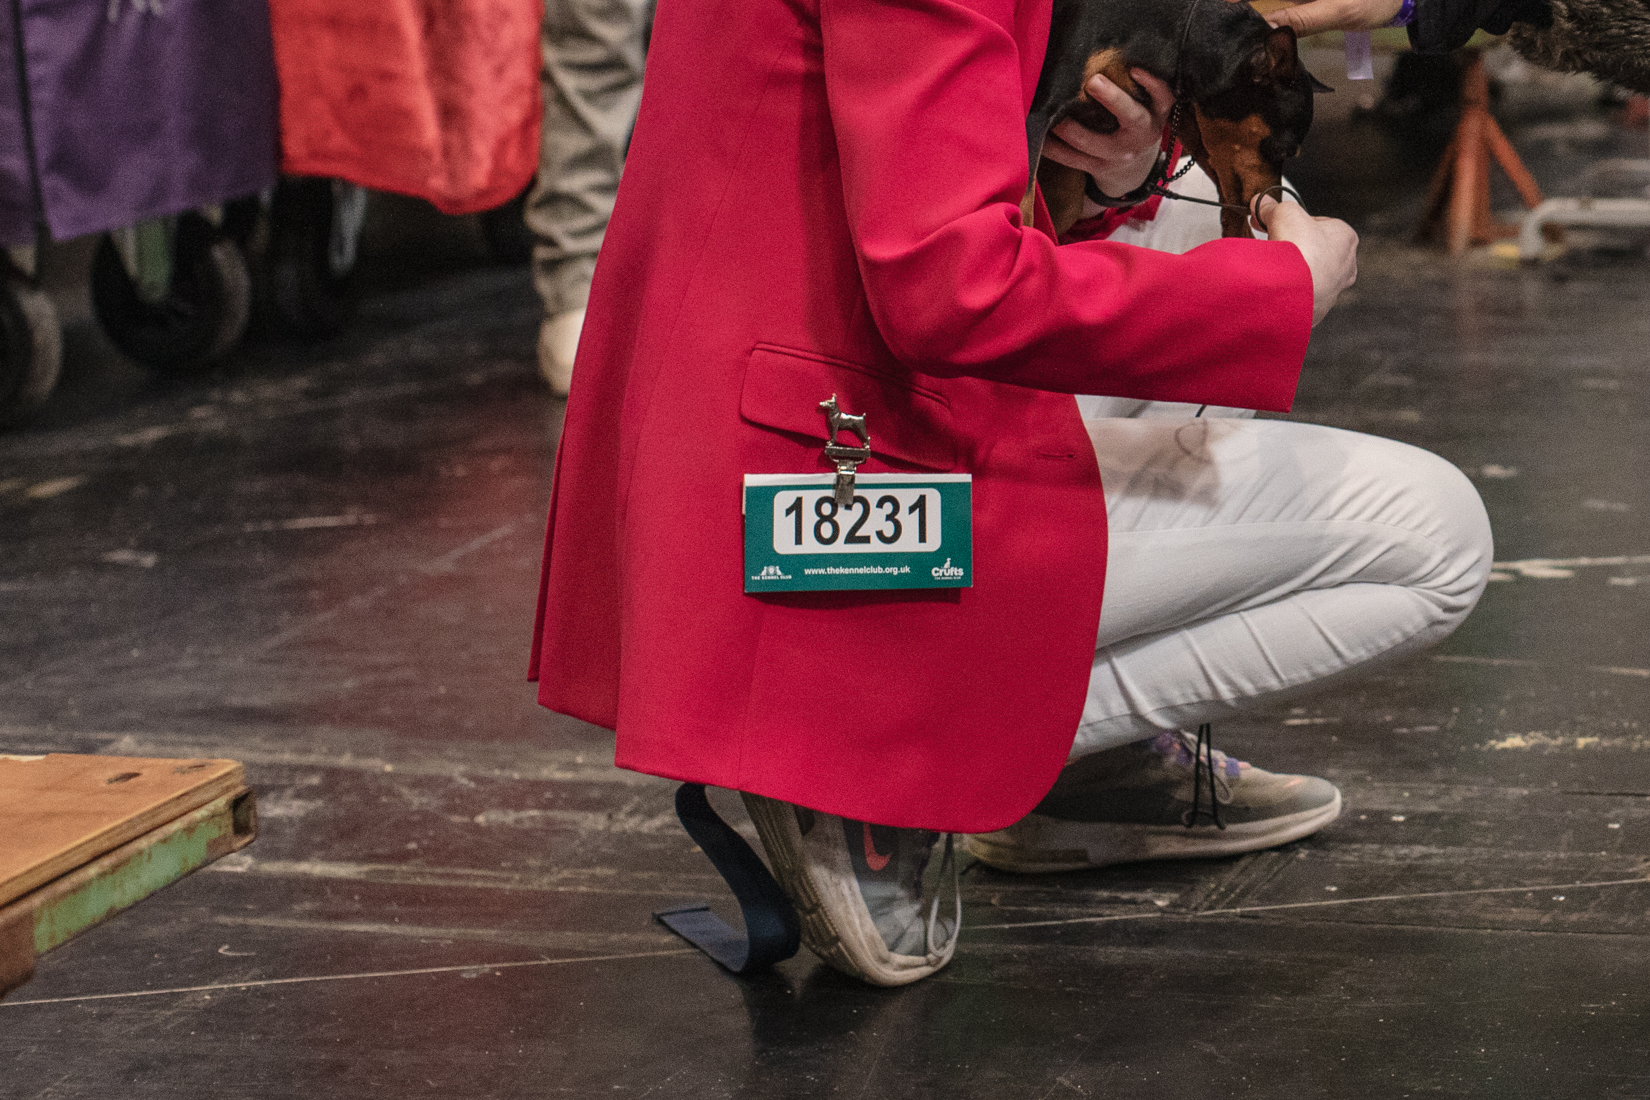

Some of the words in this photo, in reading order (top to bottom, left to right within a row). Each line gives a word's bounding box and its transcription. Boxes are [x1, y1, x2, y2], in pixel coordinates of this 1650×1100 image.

[785, 494, 927, 546] 18231
[804, 565, 911, 576] www.thekennelclub.org.uk
[931, 566, 964, 577] Crufts
